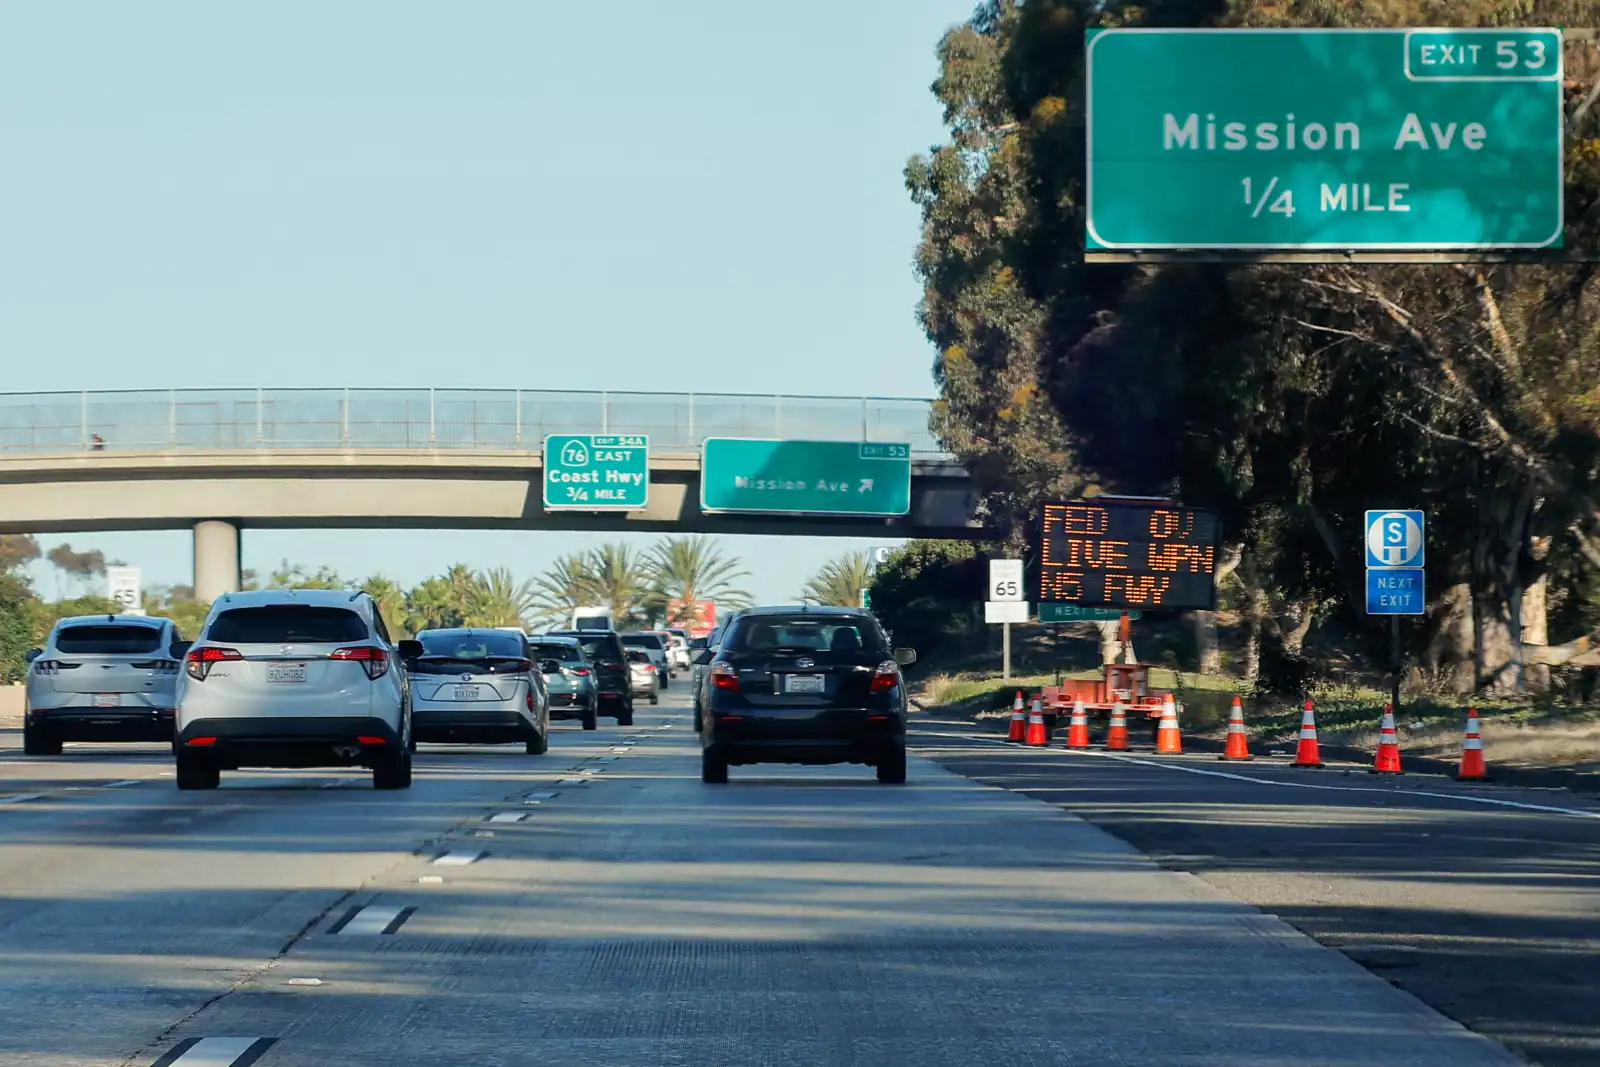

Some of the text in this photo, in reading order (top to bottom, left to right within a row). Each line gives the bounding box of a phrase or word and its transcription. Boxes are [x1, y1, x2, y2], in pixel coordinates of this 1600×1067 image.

[1420, 41, 1546, 69] EXIT 53
[1163, 113, 1487, 151] Mission Ave
[1320, 182, 1410, 212] MILE
[566, 449, 585, 462] 76
[594, 451, 632, 462] EAST
[889, 446, 906, 457] 53
[549, 469, 643, 486] Coast Hwy
[735, 475, 849, 492] Mission Ave
[594, 489, 626, 500] MILE
[1043, 504, 1109, 535] FED
[1041, 538, 1129, 569] LIVE
[996, 581, 1017, 596] 65
[1103, 574, 1170, 604] FWY
[1378, 578, 1413, 588] NEXT
[1380, 595, 1412, 606] EXIT
